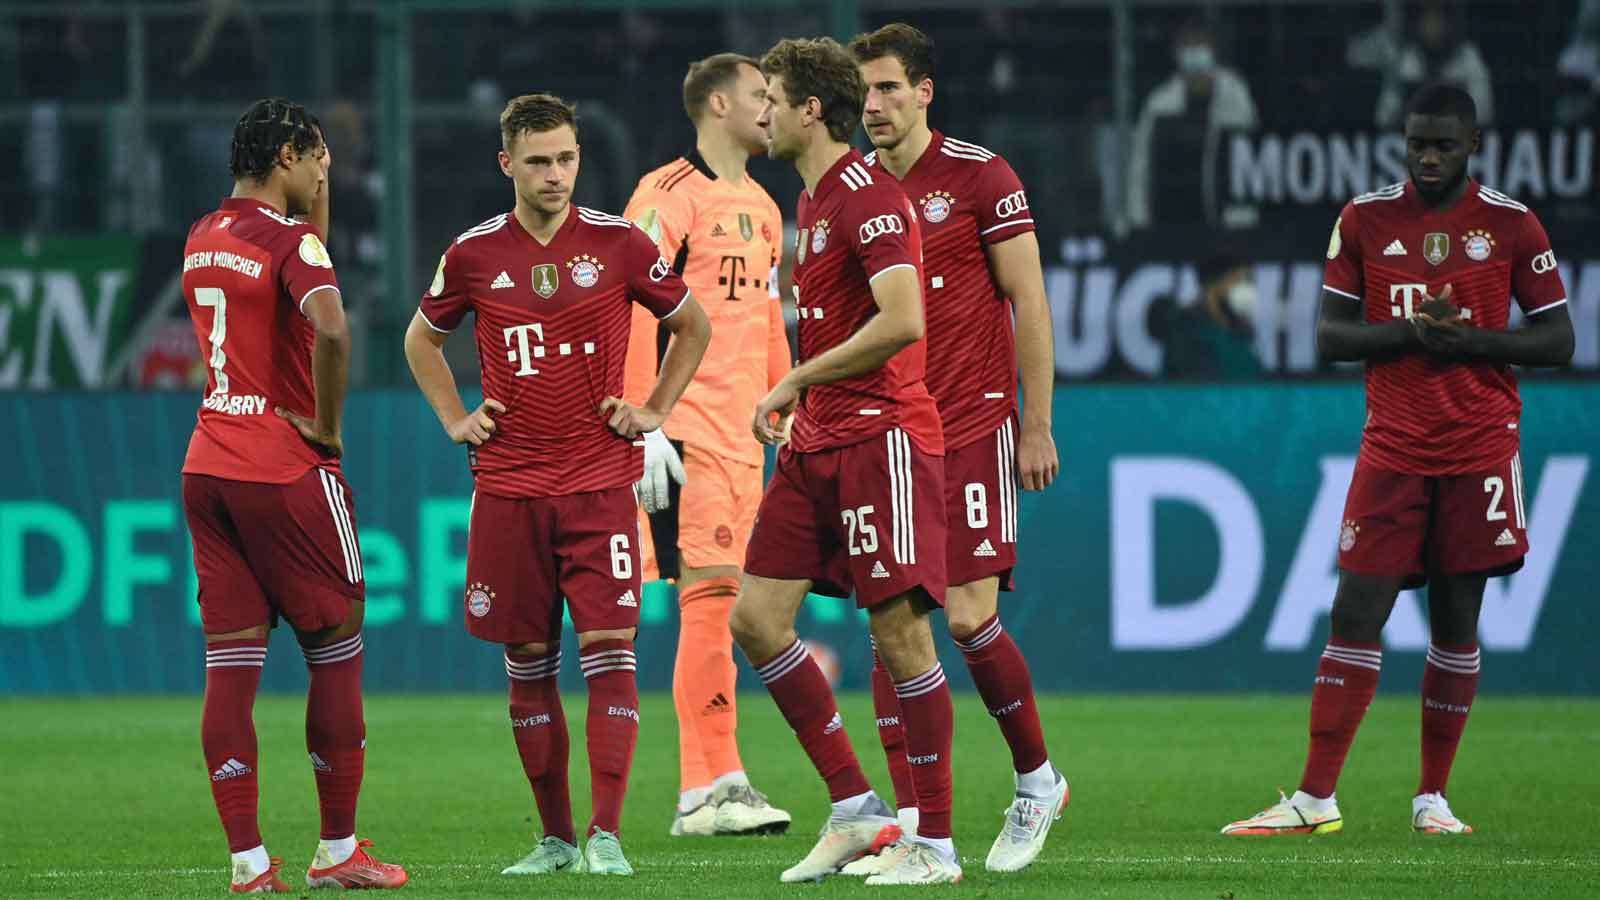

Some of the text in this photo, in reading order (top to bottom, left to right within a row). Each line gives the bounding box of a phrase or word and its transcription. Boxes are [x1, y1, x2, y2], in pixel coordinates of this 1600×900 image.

[1229, 130, 1593, 203] MONSHAU
[194, 287, 227, 394] 7
[965, 483, 988, 529] 8
[1484, 476, 1507, 521] 2
[842, 505, 879, 556] 25
[0, 501, 205, 626] DF
[610, 534, 632, 580] 6
[513, 713, 551, 728] AYERN
